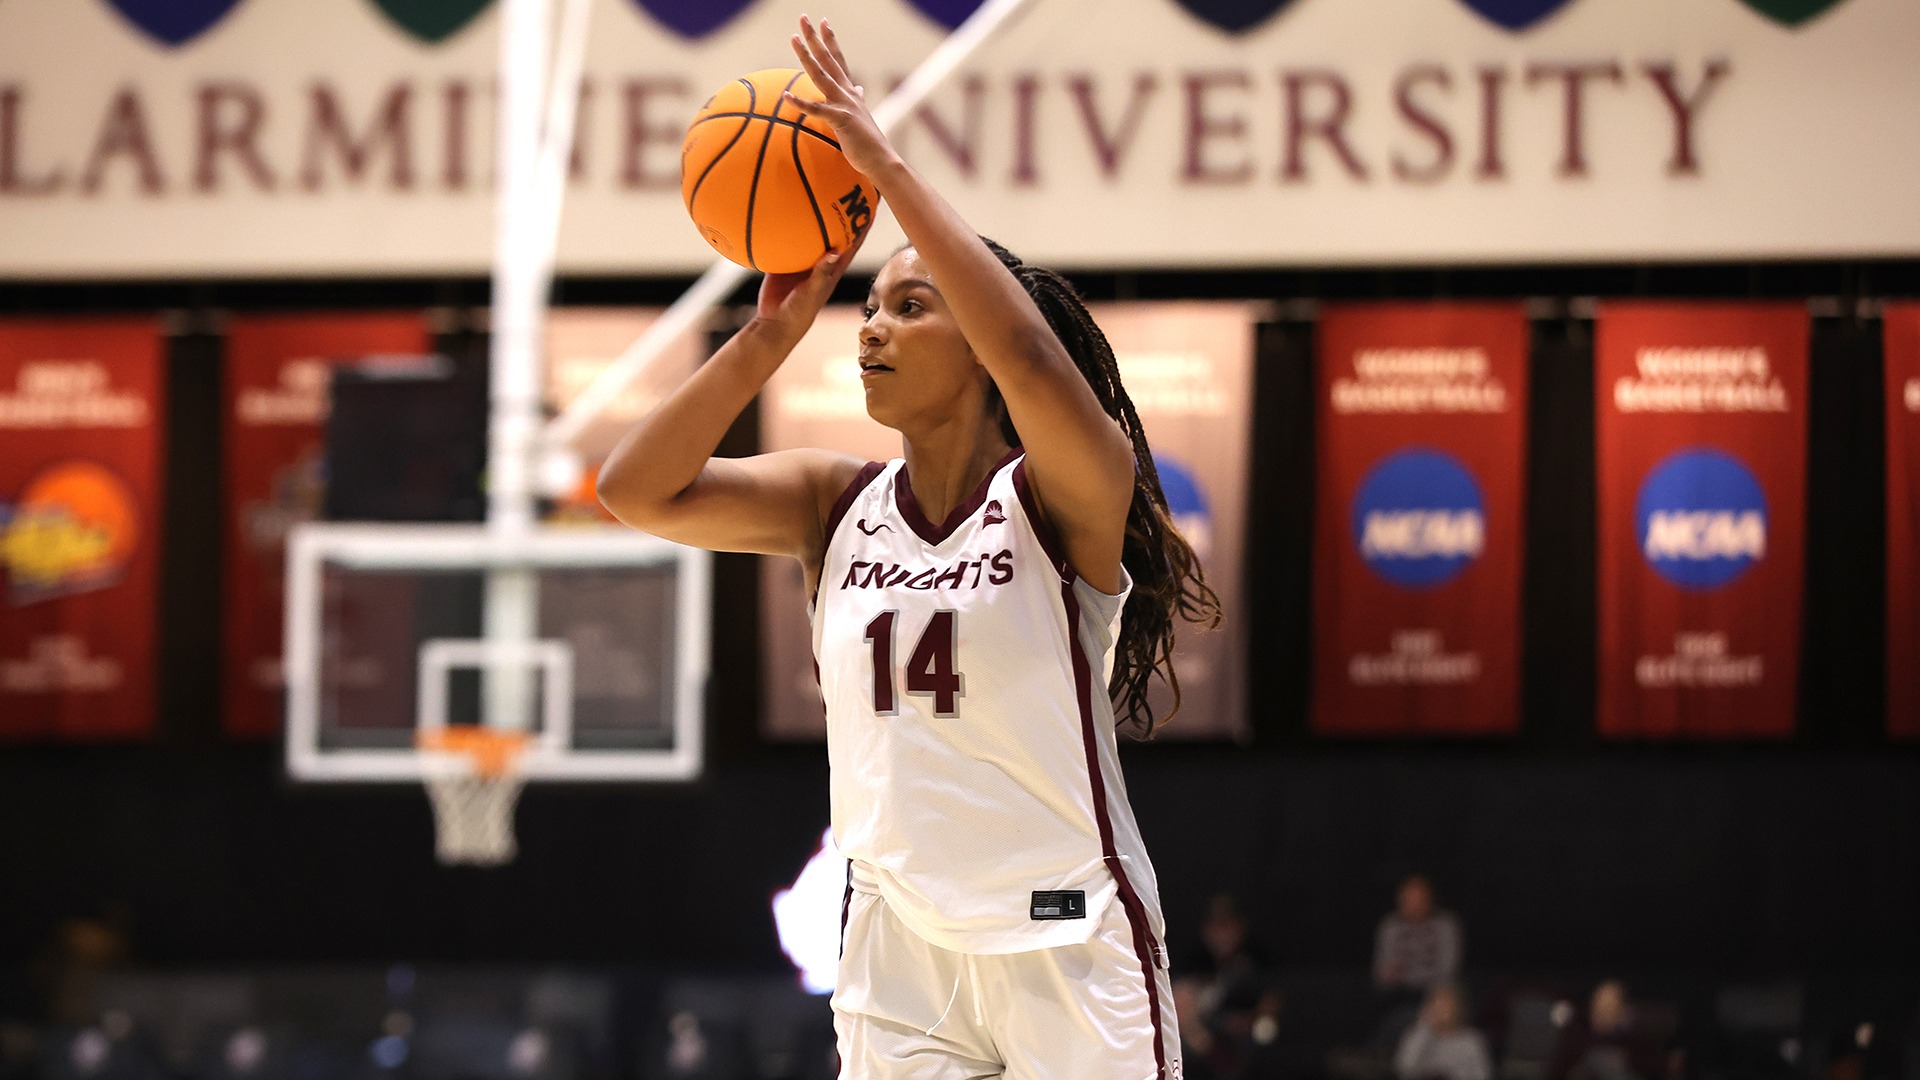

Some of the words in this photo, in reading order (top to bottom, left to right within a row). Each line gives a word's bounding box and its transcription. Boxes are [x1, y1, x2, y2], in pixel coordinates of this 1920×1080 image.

[852, 60, 1734, 186] NIVERSITY
[838, 183, 871, 243] NC
[841, 549, 1014, 590] KNIGHTS
[864, 609, 966, 718] 14
